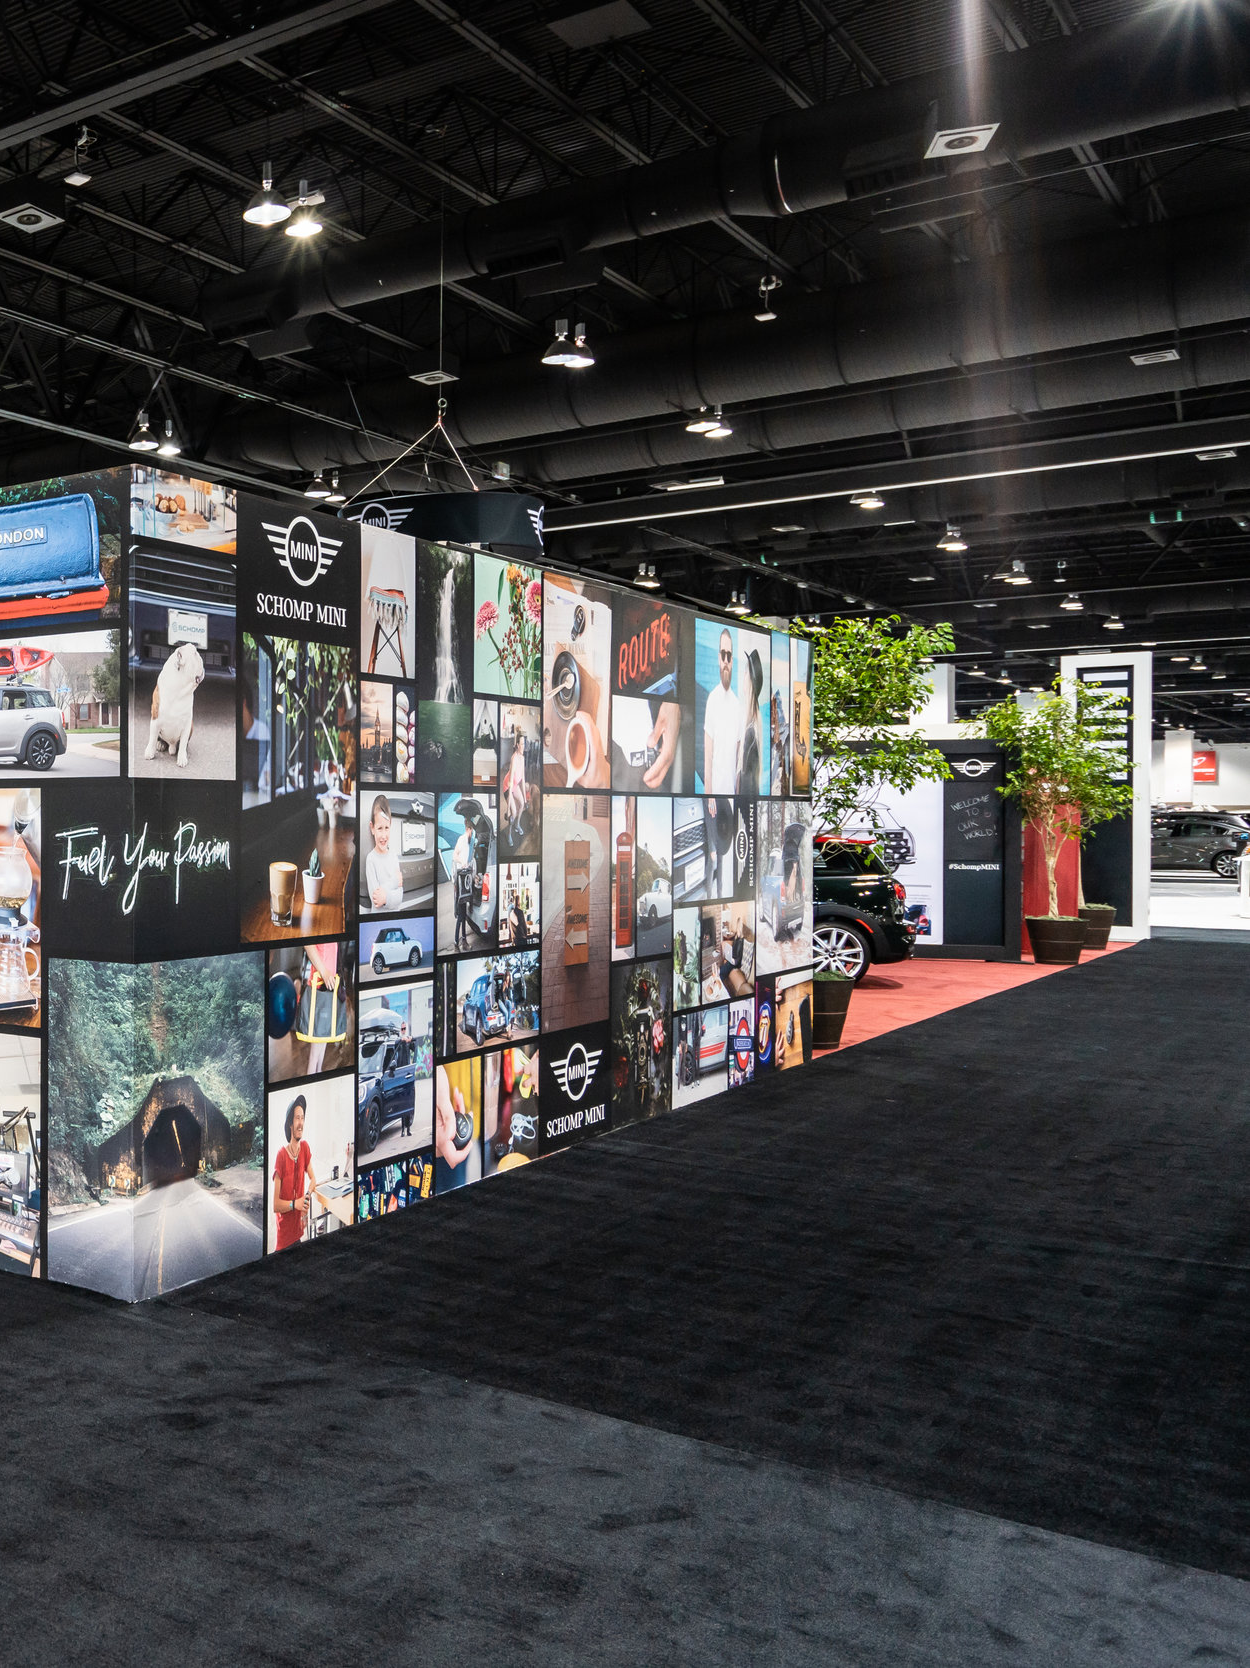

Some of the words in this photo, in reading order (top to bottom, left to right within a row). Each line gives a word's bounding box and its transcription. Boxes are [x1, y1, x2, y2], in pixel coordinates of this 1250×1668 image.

[290, 540, 317, 562] MINI
[256, 593, 313, 621] SCHOMP
[316, 604, 347, 627] MINI
[178, 624, 206, 633] SCHOMP
[618, 612, 671, 690] ROUTE
[950, 794, 990, 811] WELCOME
[965, 807, 979, 817] TO
[957, 820, 979, 832] OUR
[55, 826, 115, 899] Fuel
[122, 822, 170, 916] Your
[173, 821, 231, 905] Passion
[948, 863, 1000, 871] #SchompMINI
[568, 1063, 586, 1081] MINI
[546, 1111, 584, 1138] SCHOMP
[584, 1103, 606, 1126] MINI
